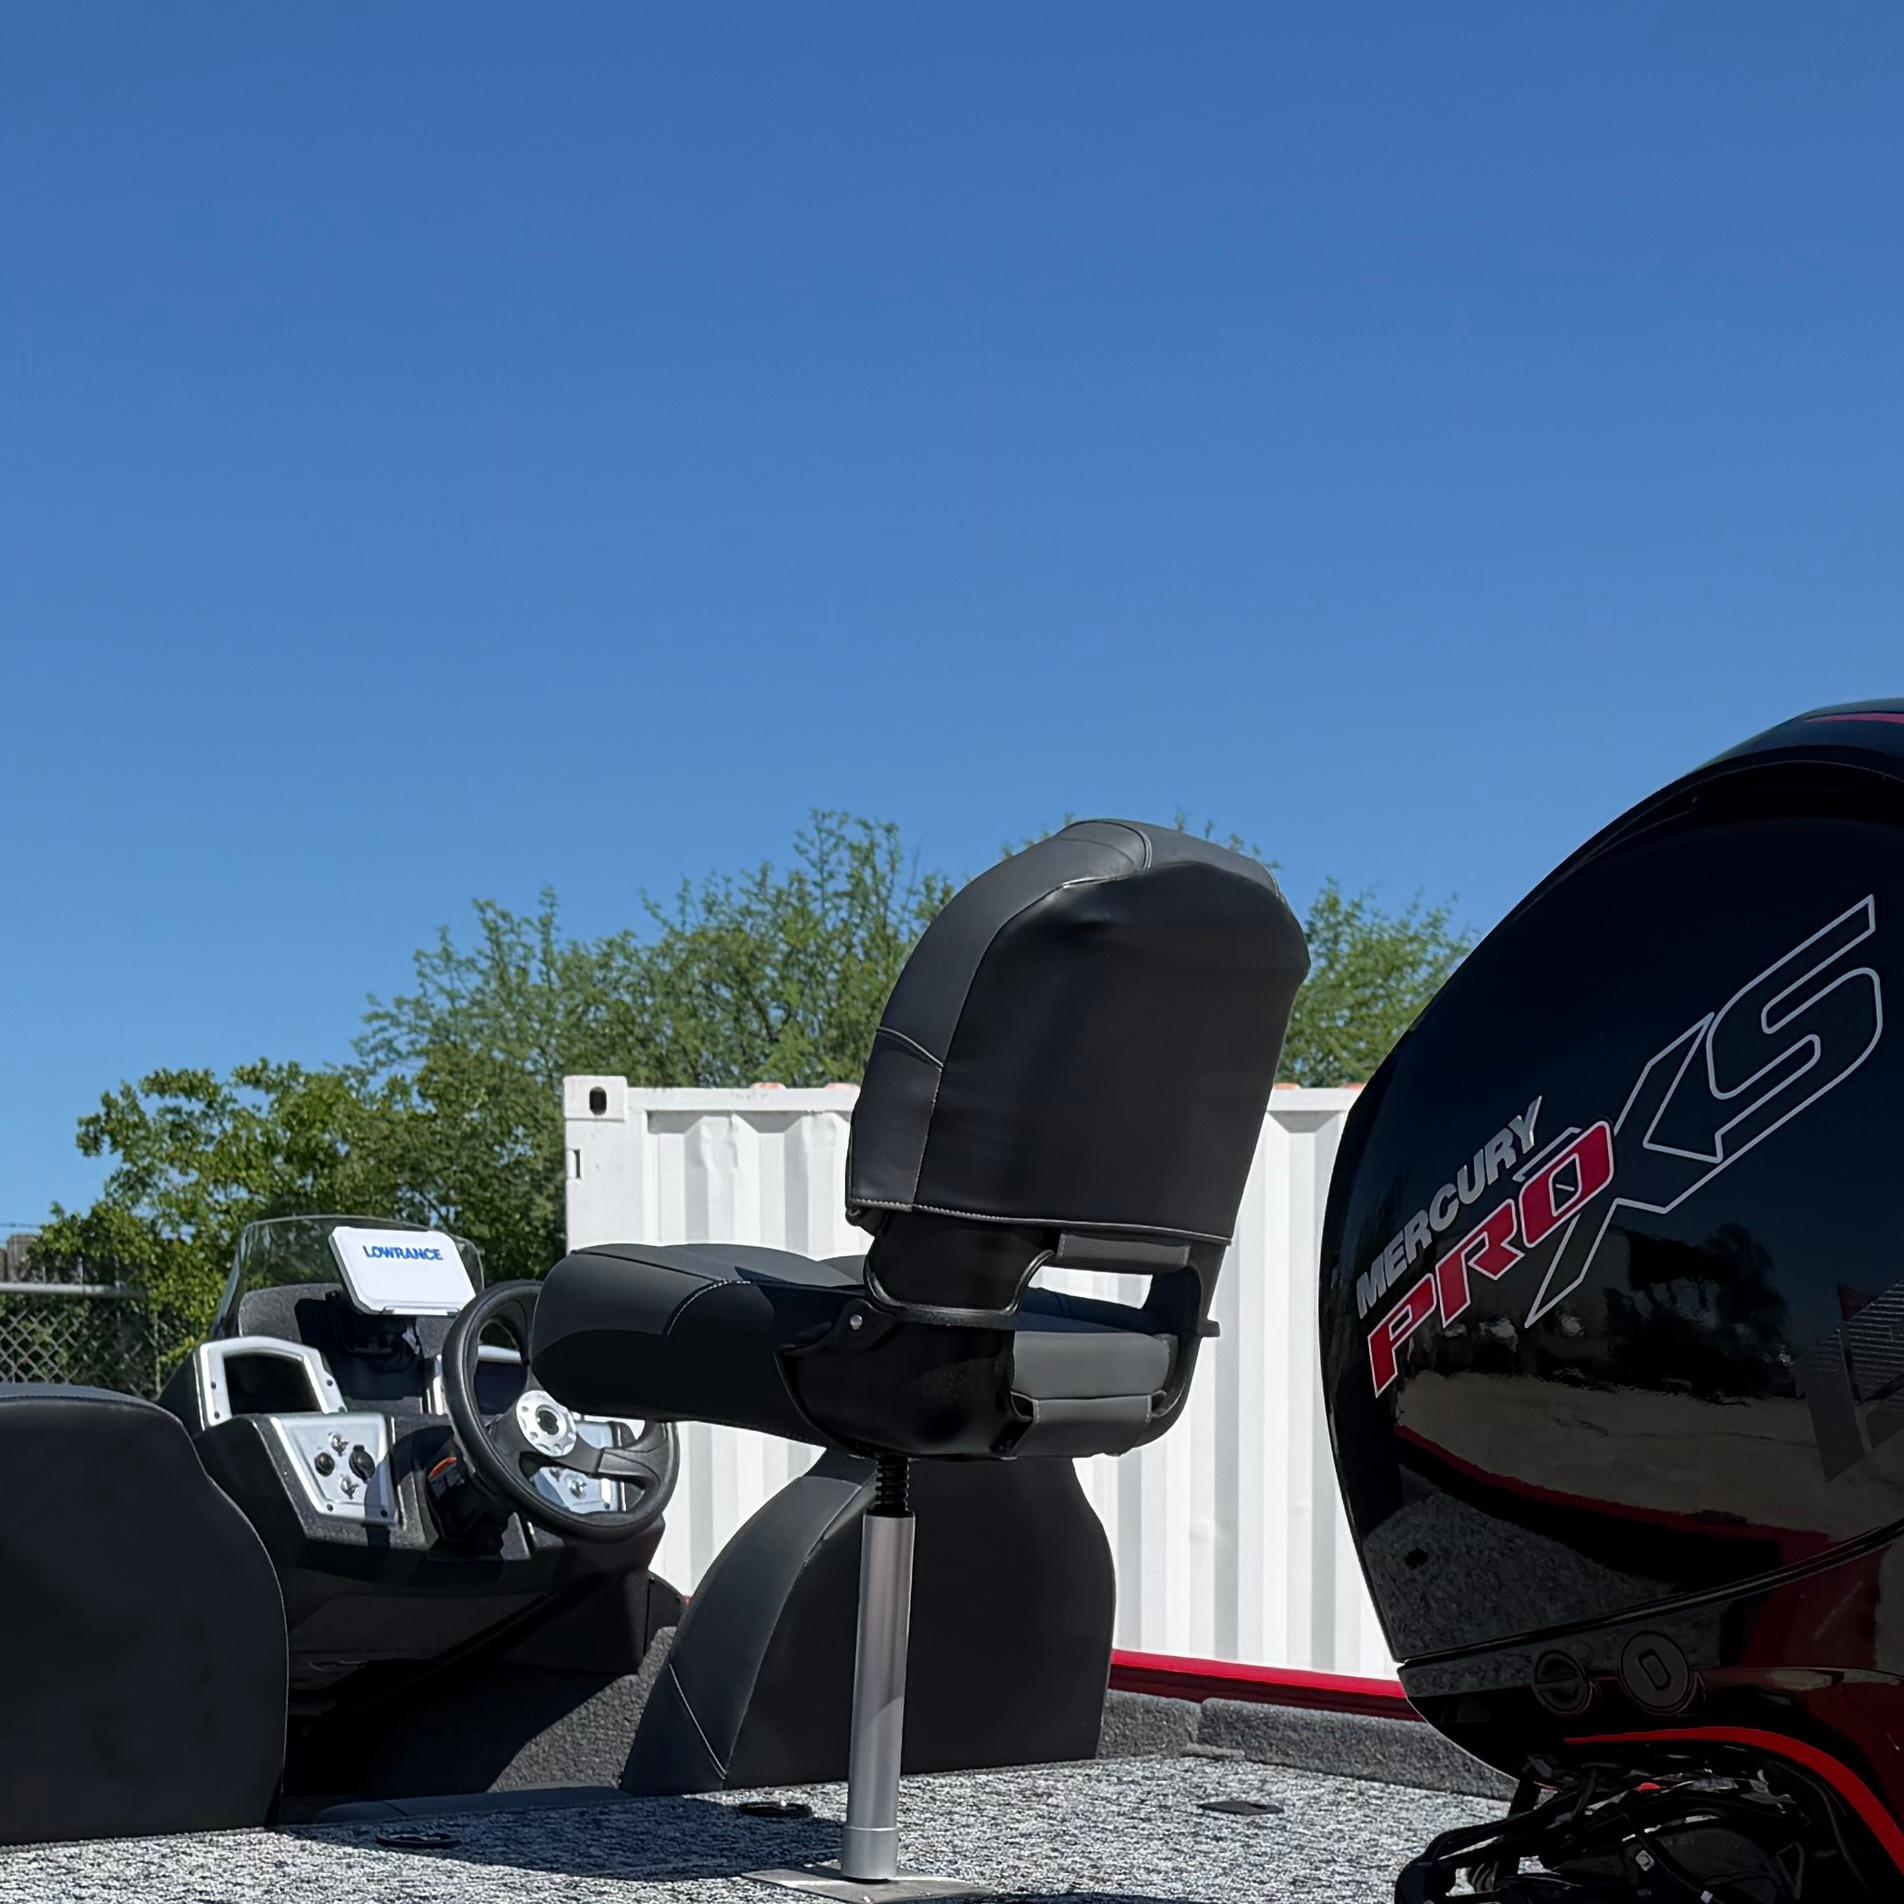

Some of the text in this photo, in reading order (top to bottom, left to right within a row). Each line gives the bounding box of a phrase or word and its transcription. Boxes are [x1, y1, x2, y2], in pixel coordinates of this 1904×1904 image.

[361, 1244, 444, 1261] LOWRANCE
[1355, 1095, 1543, 1320] MERCURY
[1367, 893, 1883, 1398] PRO XS
